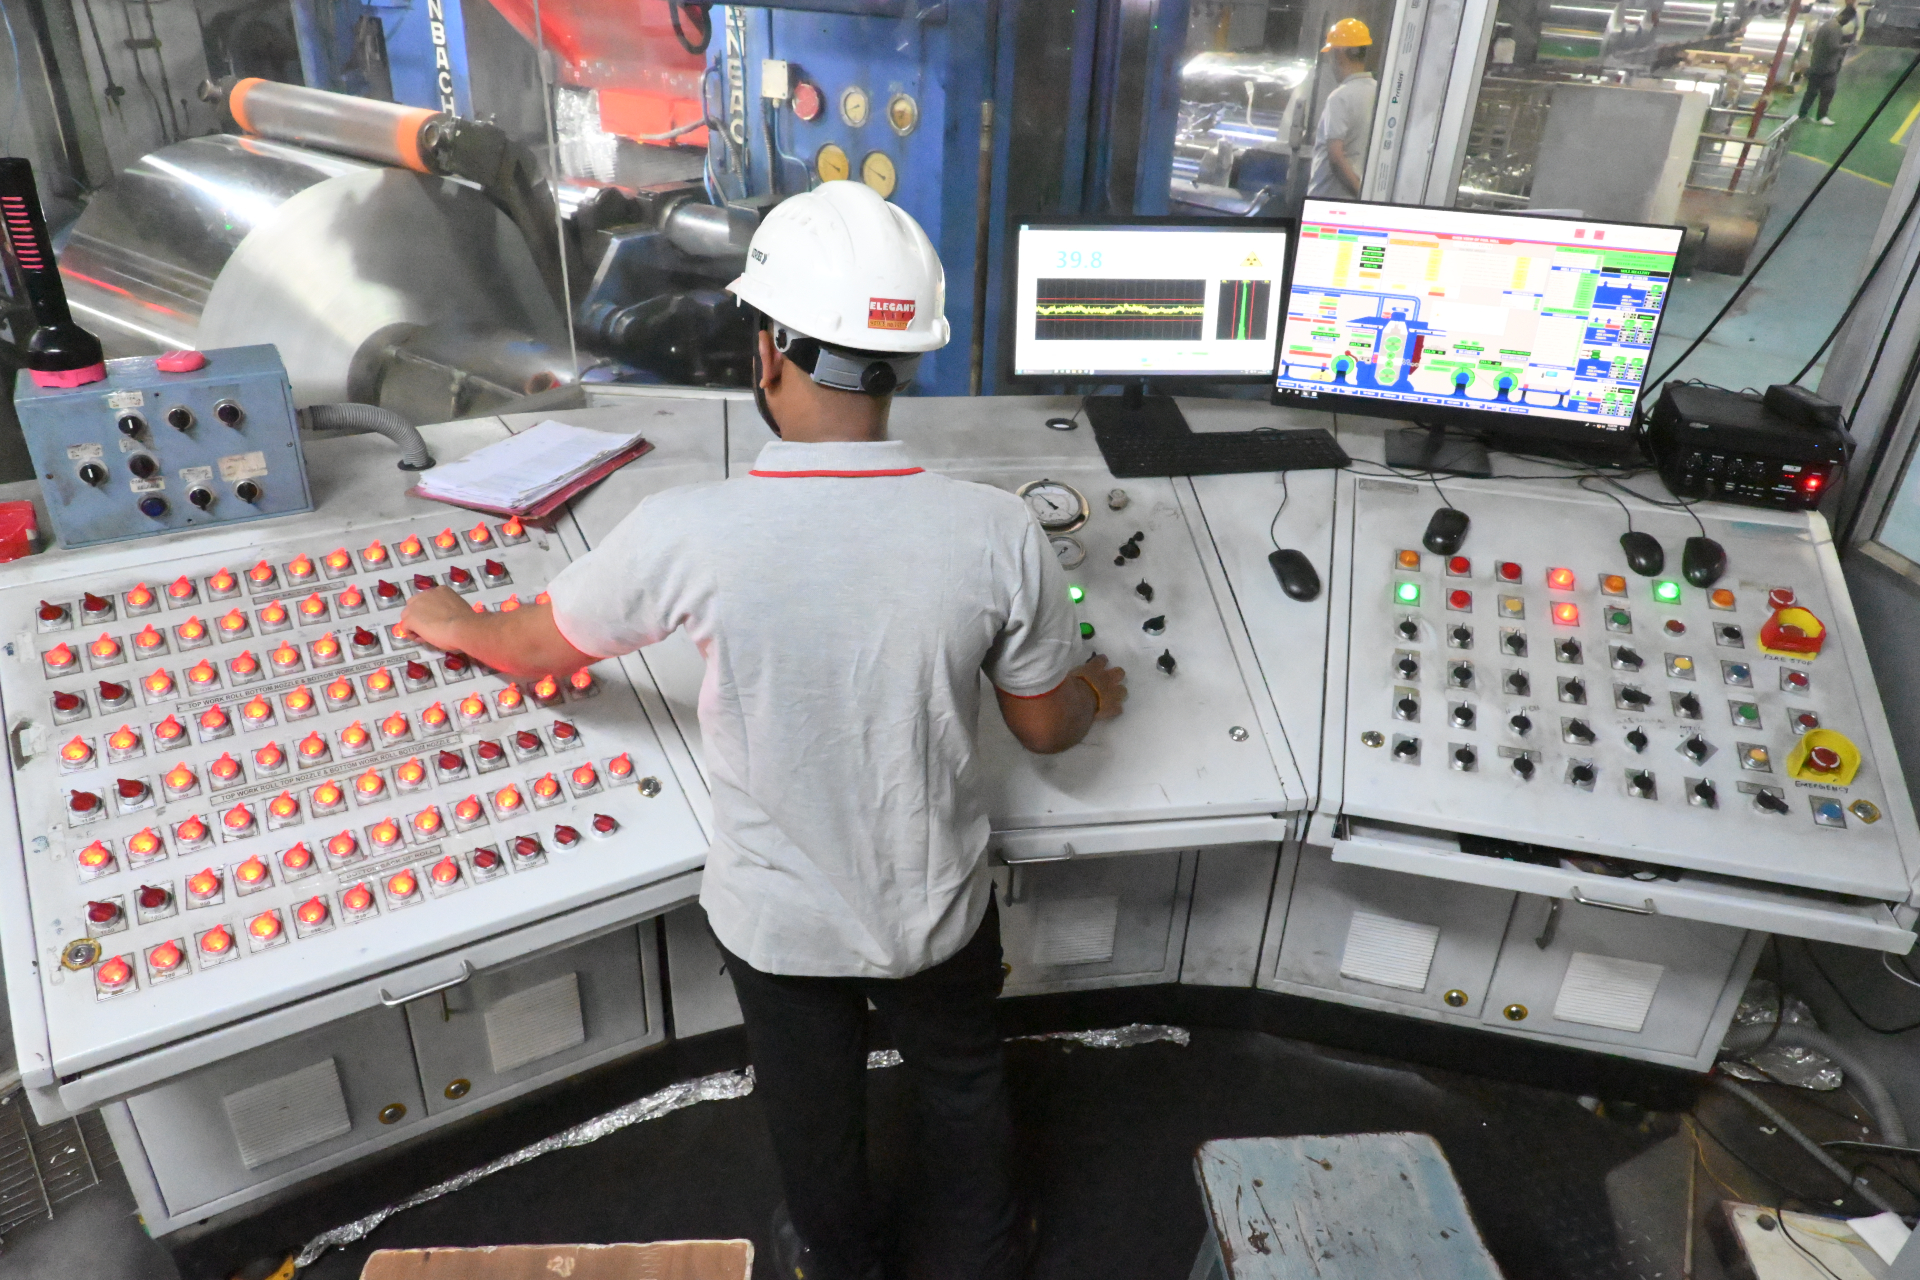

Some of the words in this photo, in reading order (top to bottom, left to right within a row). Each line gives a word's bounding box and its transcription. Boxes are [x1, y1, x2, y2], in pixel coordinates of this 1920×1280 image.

[1056, 250, 1103, 269] 39.8
[869, 302, 915, 312] ELEGANT
[1789, 656, 1813, 666] STOP
[188, 700, 201, 708] TOP
[203, 696, 225, 706] WORK
[225, 691, 244, 701] ROLL
[245, 685, 273, 696] BOTTOM
[273, 678, 300, 691] NOZZLE
[307, 670, 334, 682] BOTTOM
[334, 666, 355, 677] WORK
[356, 662, 373, 672] ROLL
[373, 659, 385, 668] TOP
[221, 793, 236, 802] TOP
[236, 787, 259, 799] WORK
[260, 782, 279, 793] ROLL
[280, 778, 294, 786] TOP
[295, 771, 322, 784] NOZZLE
[329, 761, 358, 774] BOTTOM
[358, 756, 380, 767] WORK
[380, 752, 399, 762] ROLL
[399, 745, 426, 756] BOTTOM
[426, 739, 451, 749] NOZZLE
